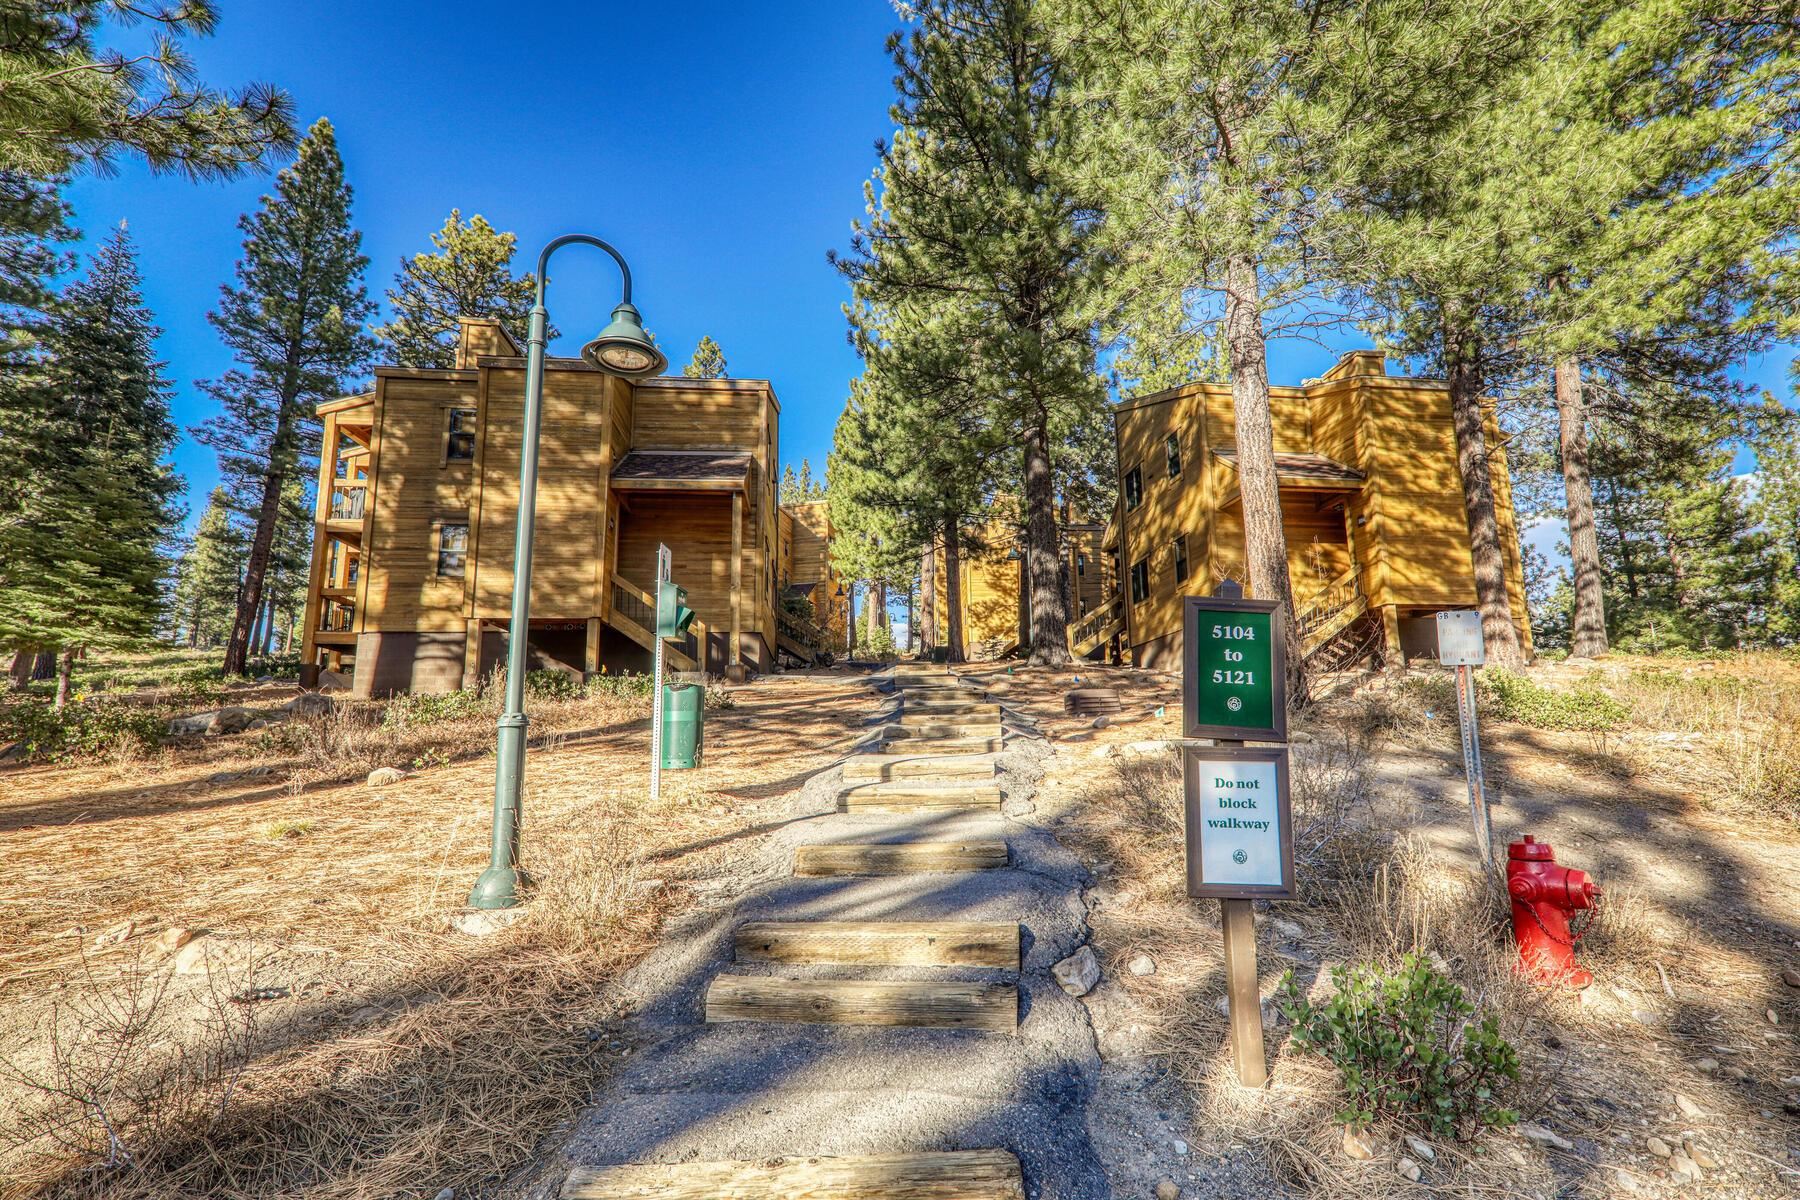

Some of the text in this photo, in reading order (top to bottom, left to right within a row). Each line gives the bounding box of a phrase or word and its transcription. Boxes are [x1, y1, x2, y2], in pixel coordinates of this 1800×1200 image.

[1212, 625, 1255, 640] 5104
[1224, 648, 1243, 661] to
[1212, 670, 1255, 685] 5121
[1215, 777, 1260, 789] Do not
[1219, 798, 1257, 809] block
[1208, 818, 1270, 832] walkway
